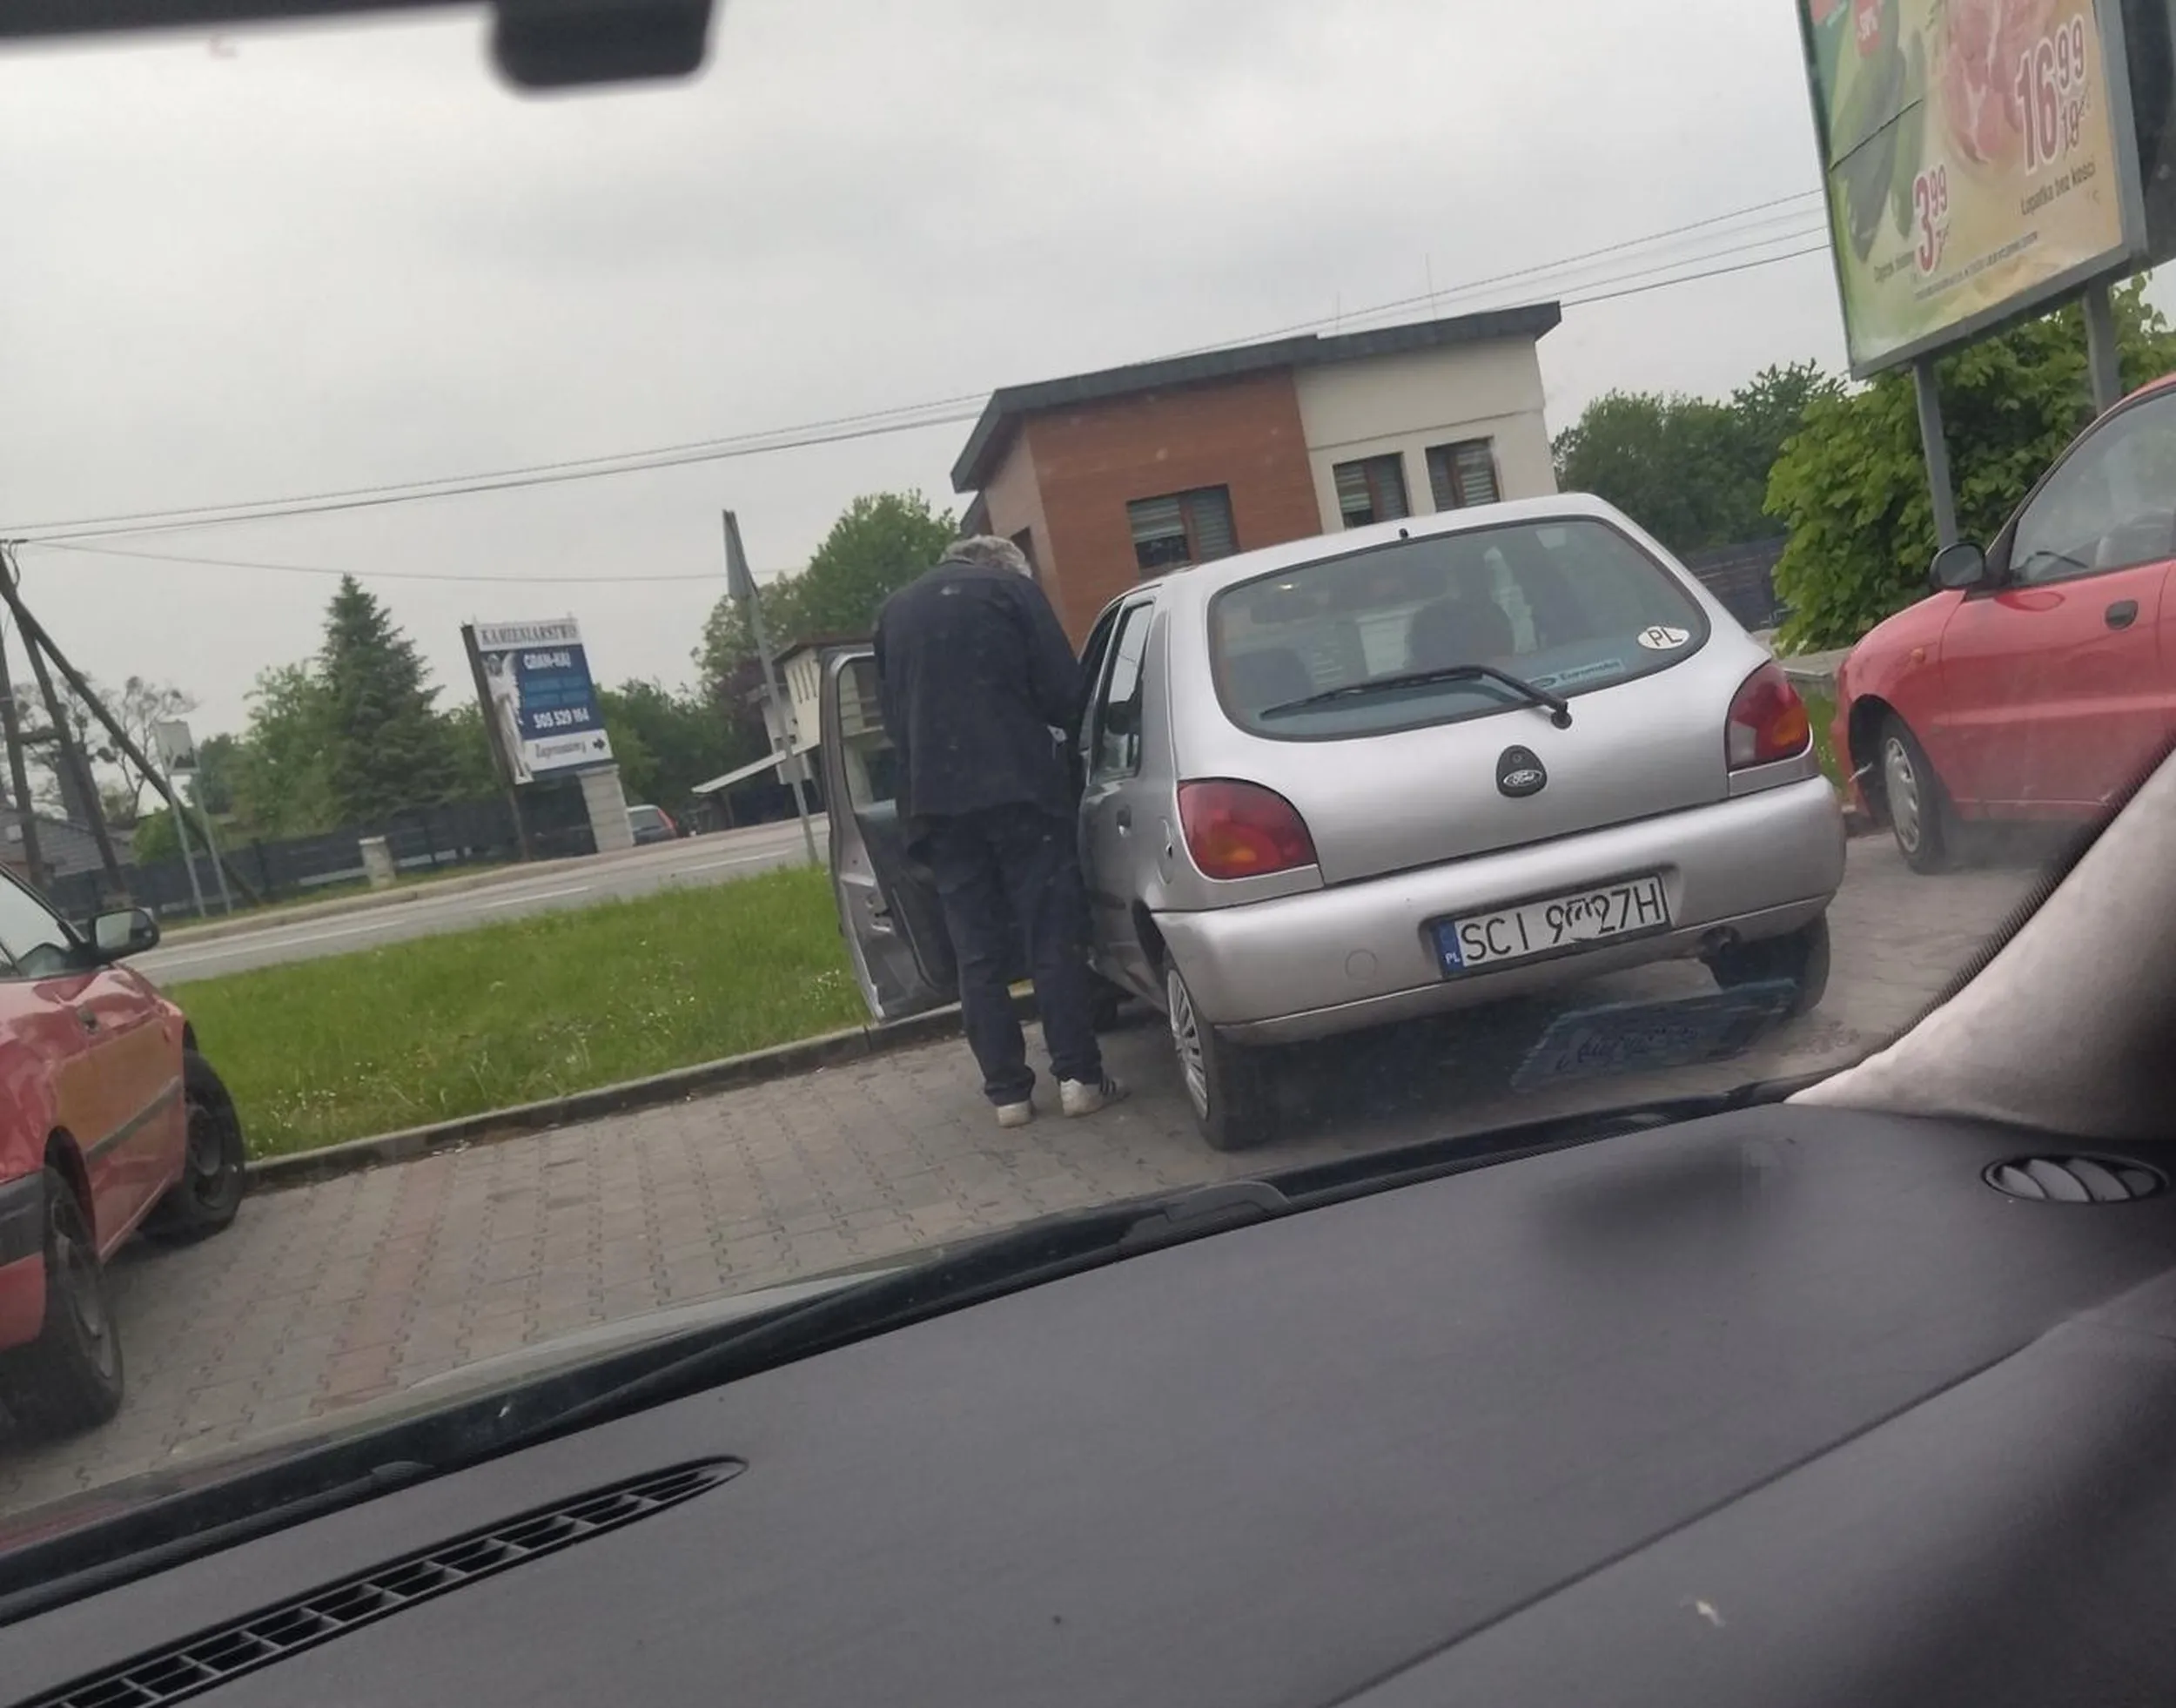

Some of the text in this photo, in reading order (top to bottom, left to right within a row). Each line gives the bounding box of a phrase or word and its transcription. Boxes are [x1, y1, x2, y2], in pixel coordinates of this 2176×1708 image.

[1647, 627, 1683, 647] PL
[1461, 912, 1529, 961] SCI
[1446, 953, 1461, 965] PL
